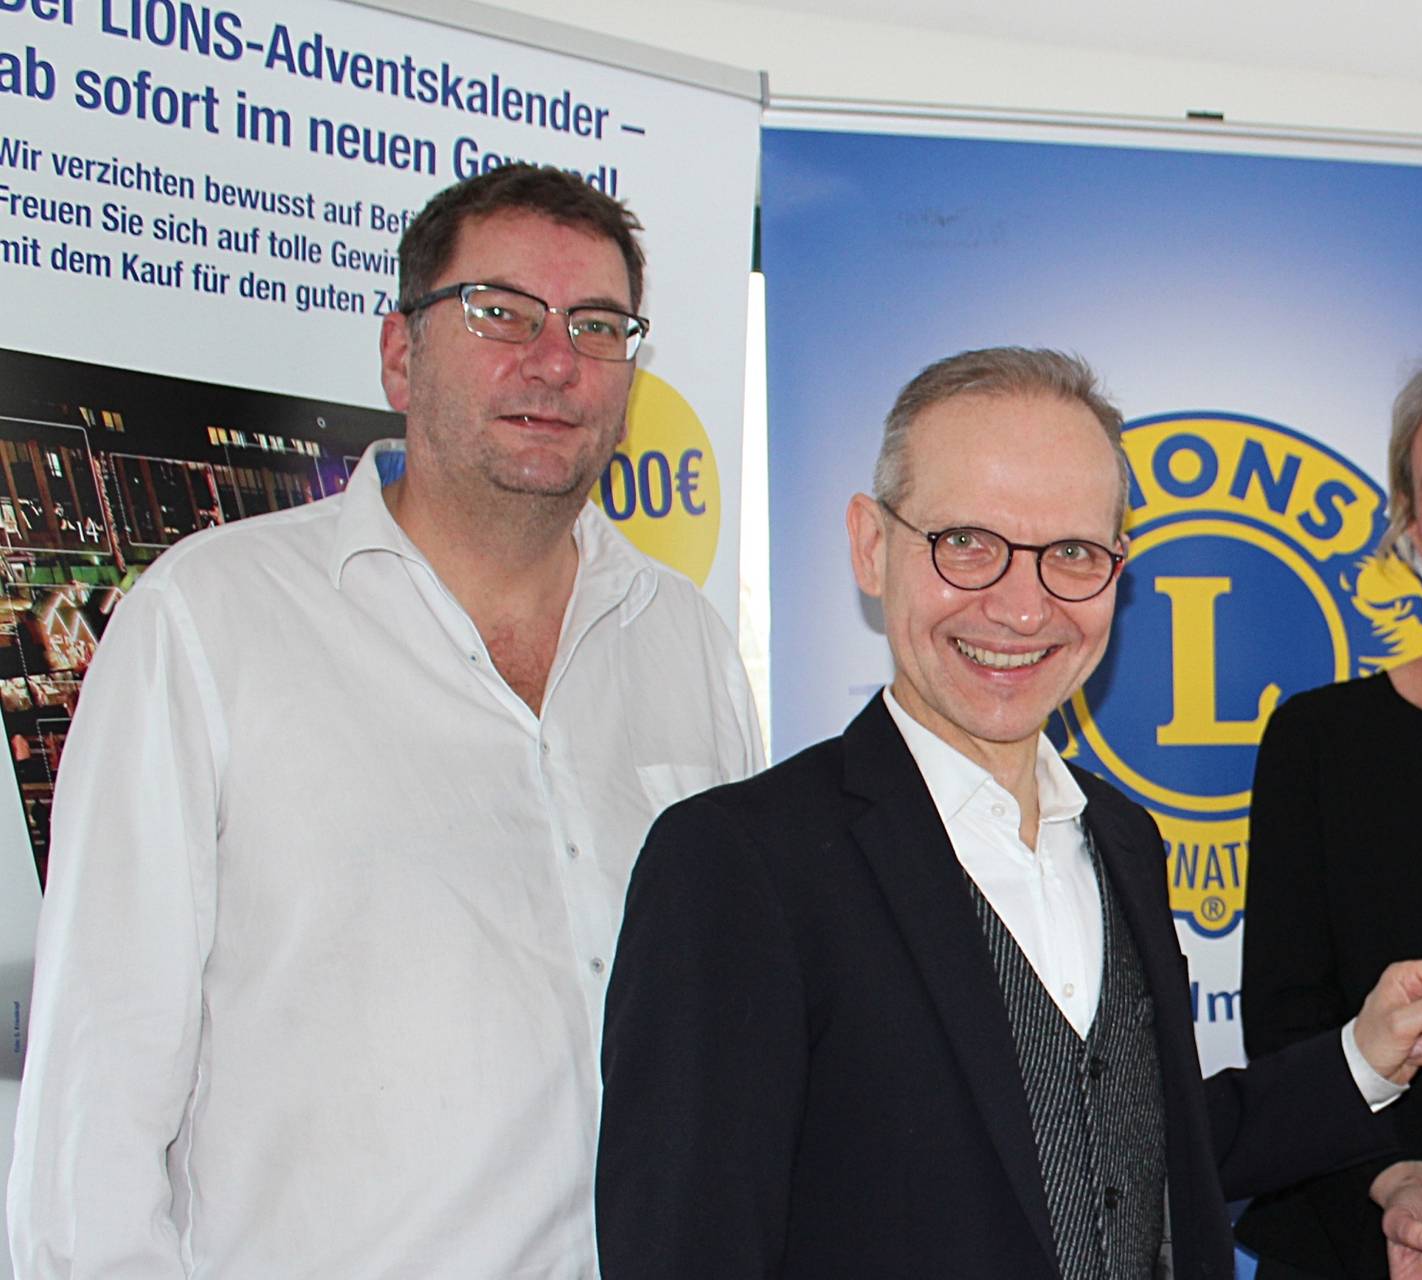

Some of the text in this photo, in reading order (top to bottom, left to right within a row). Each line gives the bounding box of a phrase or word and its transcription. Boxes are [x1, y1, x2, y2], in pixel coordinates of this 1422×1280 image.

[0, 46, 56, 100] ab
[75, 70, 219, 134] sofort
[237, 90, 291, 147] im
[309, 117, 436, 175] neuen
[0, 137, 416, 235] Wir verzichten bewusst auf Bef
[102, 203, 143, 235] Sie
[153, 213, 207, 246] sich
[217, 227, 260, 254] auf
[268, 231, 321, 264] tolle
[0, 236, 41, 267] mit
[51, 242, 111, 278] dem
[122, 252, 183, 287] Kauf
[192, 263, 230, 294] für
[239, 272, 286, 301] den
[296, 284, 364, 313] guten
[76, 518, 100, 543] 14
[1163, 838, 1249, 890] NAT
